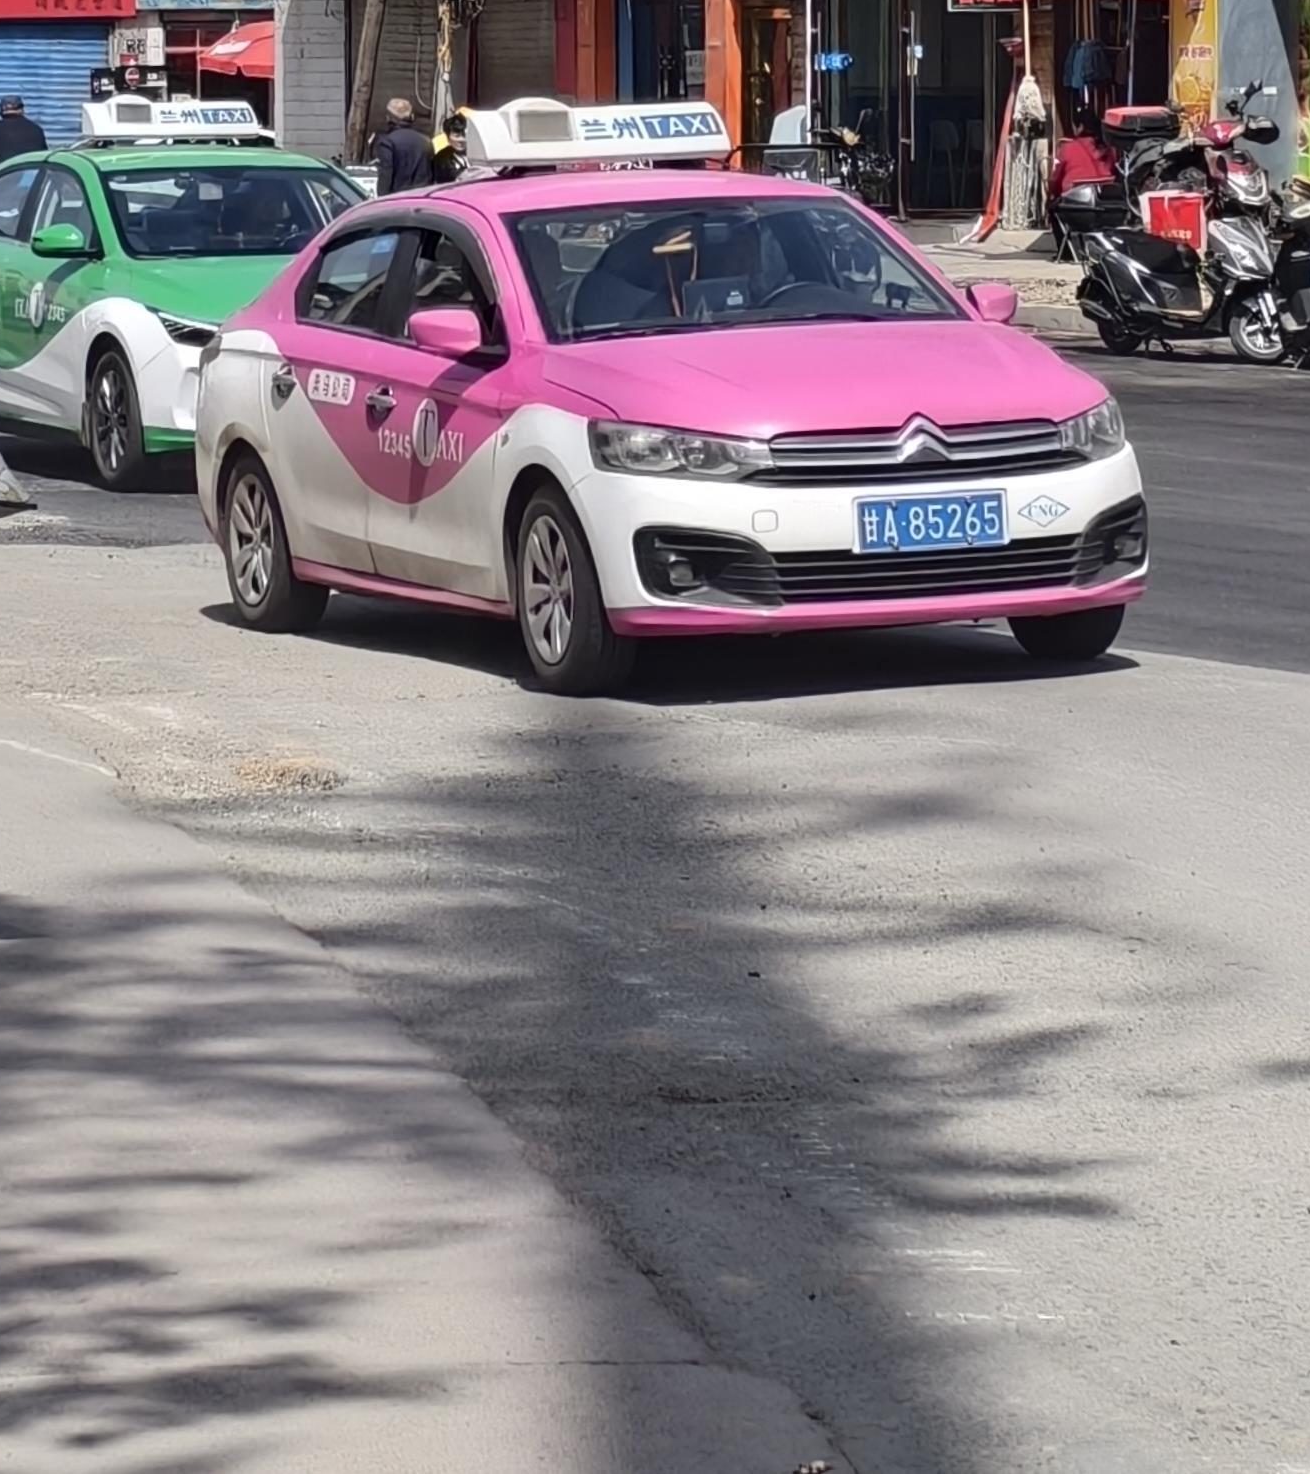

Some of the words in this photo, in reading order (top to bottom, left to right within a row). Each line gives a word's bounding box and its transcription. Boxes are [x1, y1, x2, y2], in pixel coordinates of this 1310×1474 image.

[203, 109, 253, 124] TAXI
[580, 116, 644, 141] 兰州
[645, 114, 718, 137] TAXI
[378, 427, 411, 460] 12345
